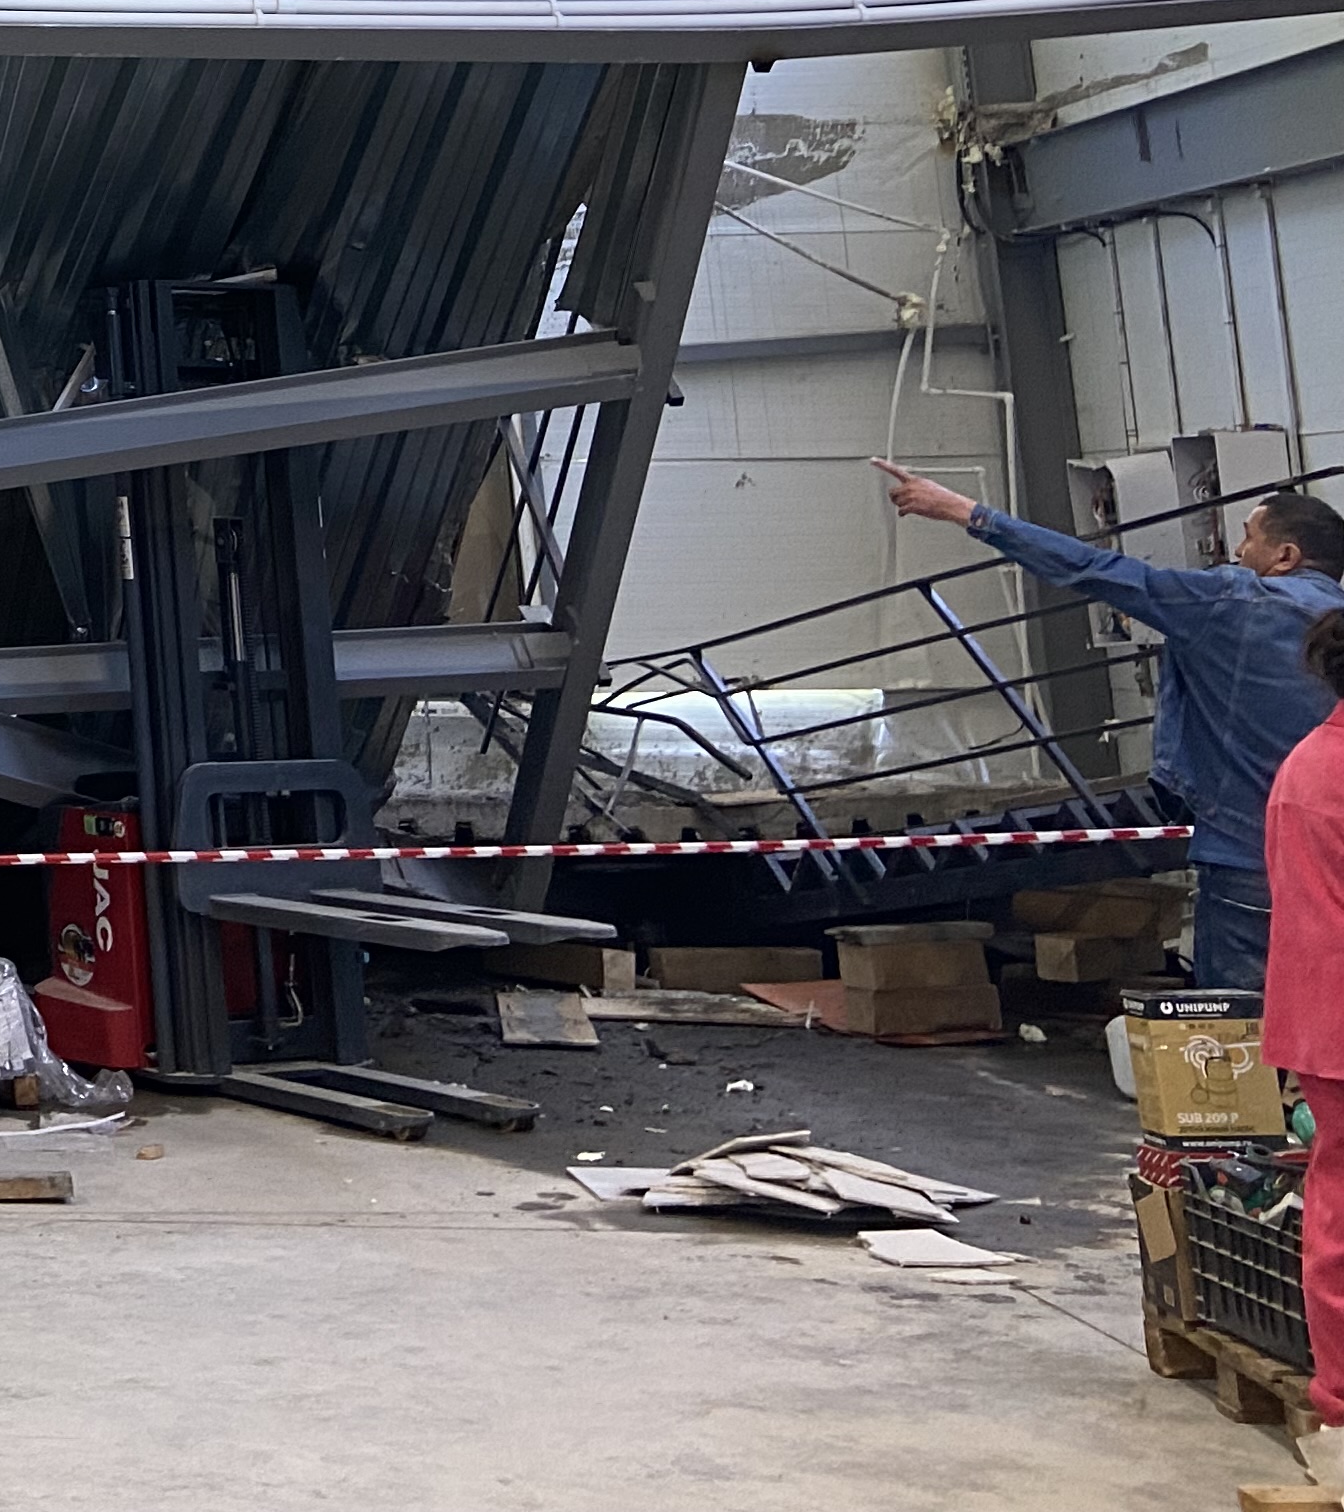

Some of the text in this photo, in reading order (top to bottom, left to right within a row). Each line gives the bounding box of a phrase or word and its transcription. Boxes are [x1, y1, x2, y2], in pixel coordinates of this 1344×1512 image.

[92, 849, 114, 953] JAC
[1175, 1001, 1231, 1013] UNIPUMP
[1176, 1112, 1204, 1125] SUB
[1205, 1112, 1229, 1125] 209
